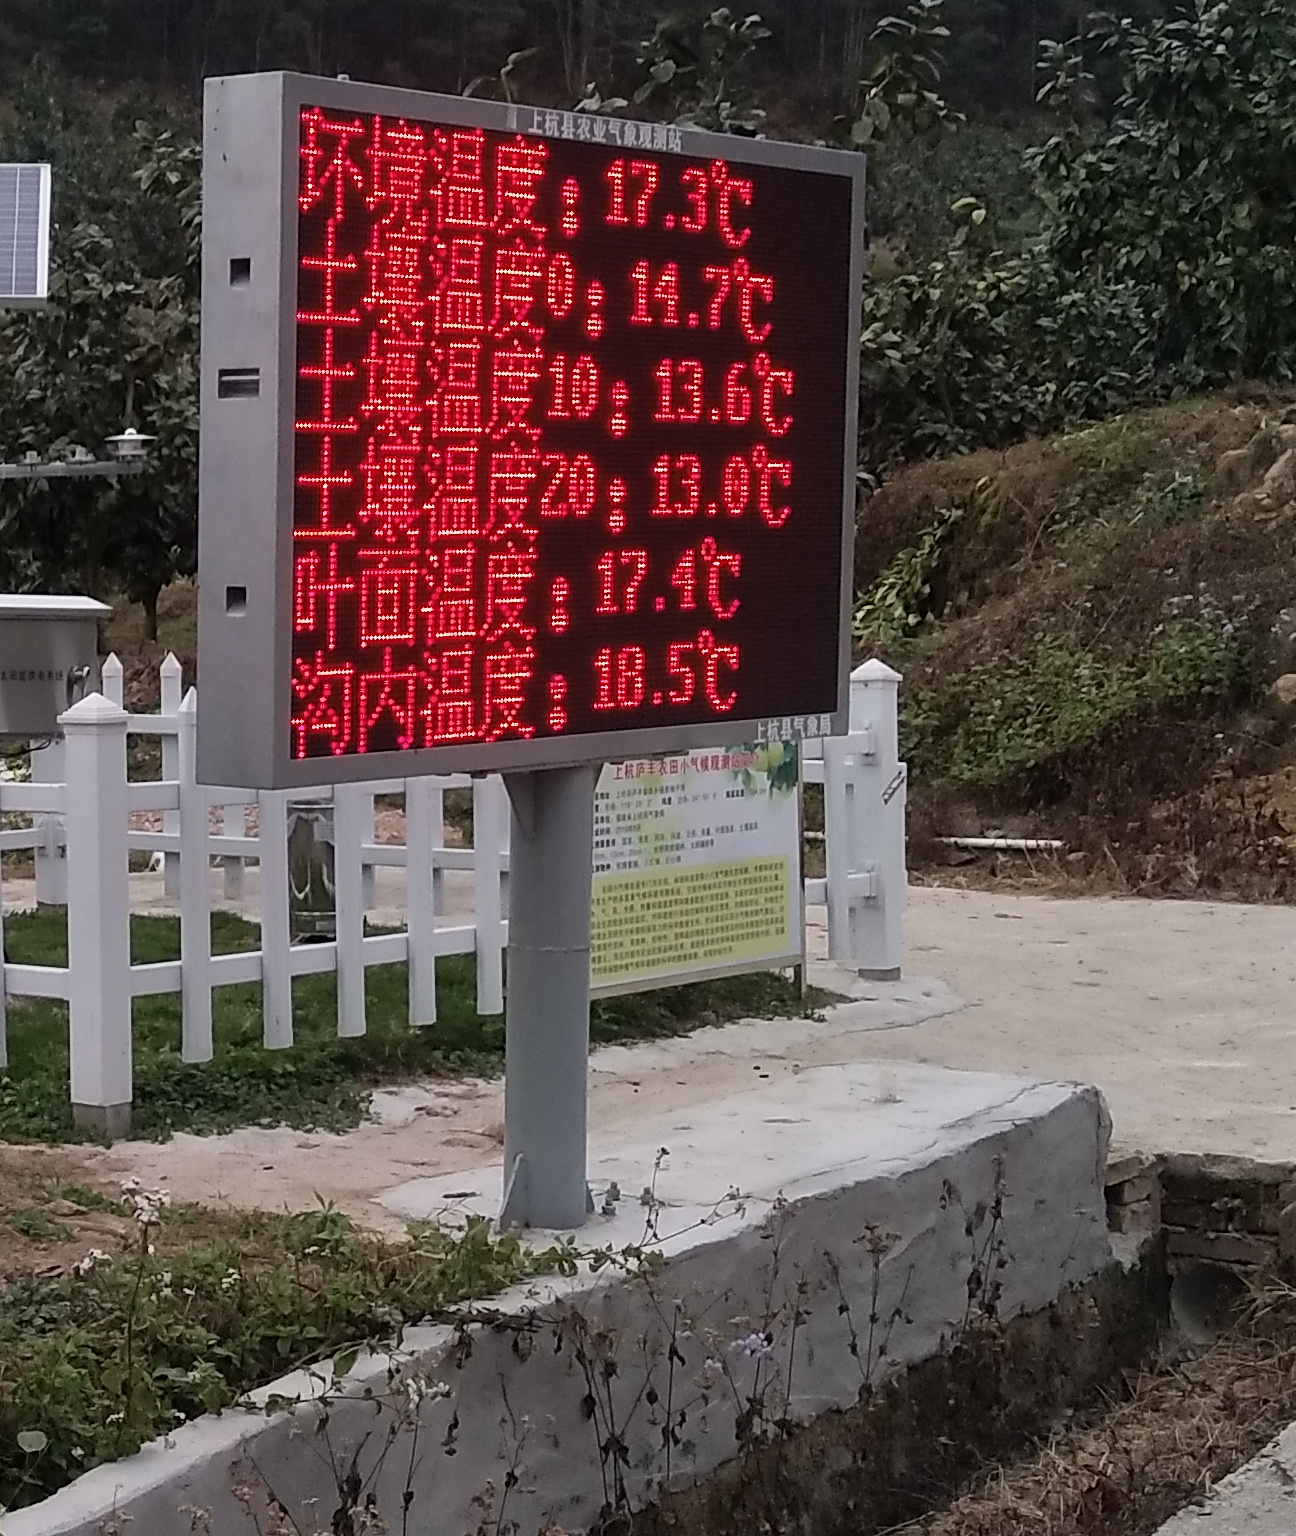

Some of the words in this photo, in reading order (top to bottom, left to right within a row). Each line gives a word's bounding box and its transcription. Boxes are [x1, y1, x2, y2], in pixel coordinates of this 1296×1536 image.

[528, 108, 682, 152] 上杭县农业气象观测站
[754, 715, 832, 744] 上杭县气象局
